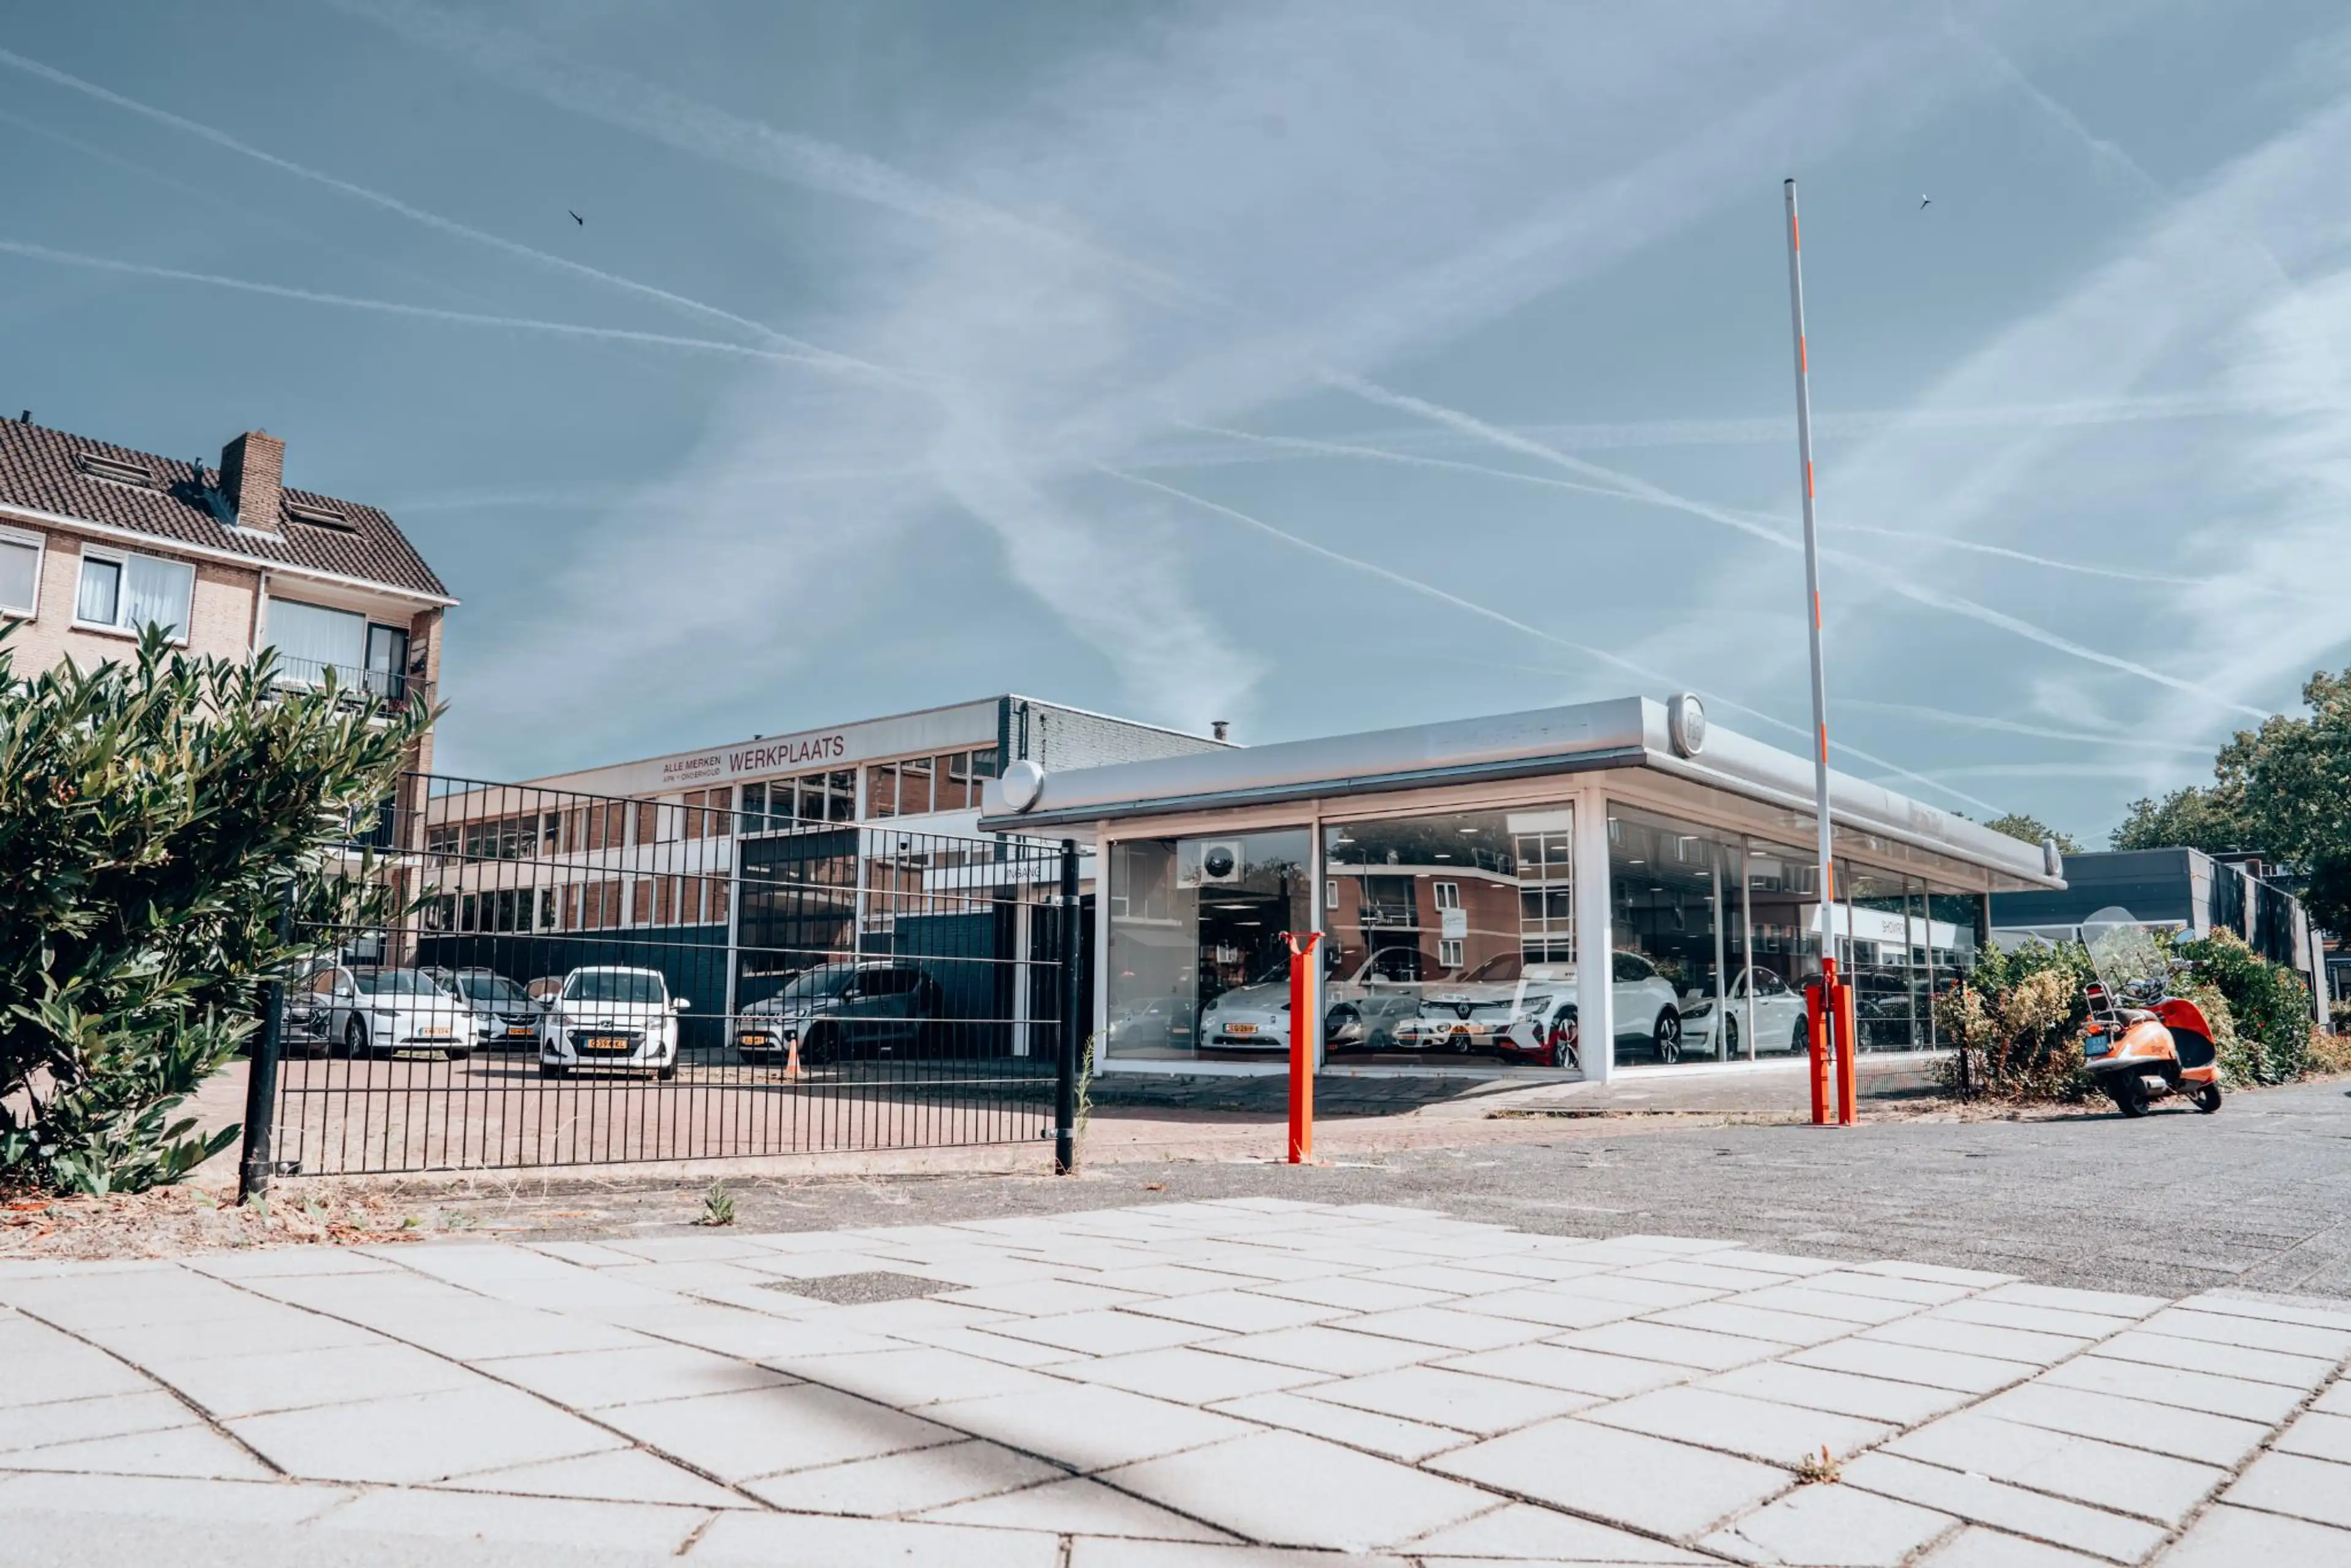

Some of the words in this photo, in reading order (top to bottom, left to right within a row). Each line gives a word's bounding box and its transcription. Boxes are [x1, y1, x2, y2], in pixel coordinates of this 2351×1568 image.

[663, 762, 684, 773] ALLE
[685, 755, 721, 770] MERKEN
[729, 735, 844, 772] WERKPLAATS
